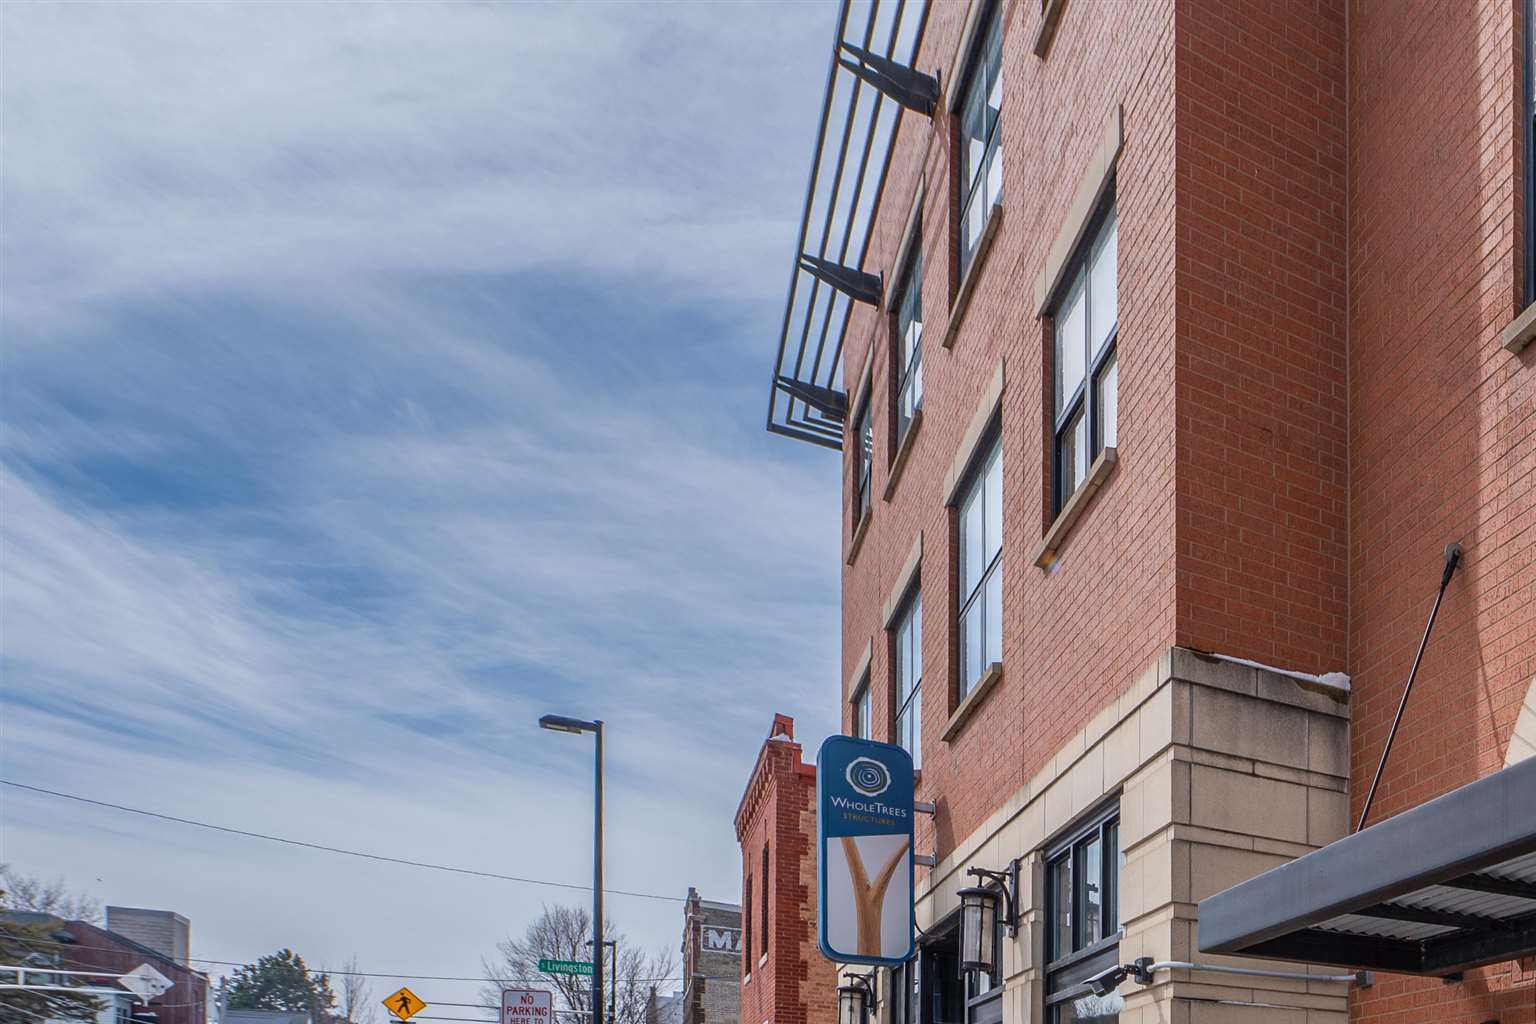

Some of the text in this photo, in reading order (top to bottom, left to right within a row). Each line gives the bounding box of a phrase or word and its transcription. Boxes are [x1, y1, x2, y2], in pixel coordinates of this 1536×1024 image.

[842, 813, 897, 826] STRUCTURES
[547, 961, 593, 974] Livingston
[520, 995, 534, 1005] NO
[506, 1006, 547, 1016] PARKING
[510, 1017, 544, 1024] HERE TO
